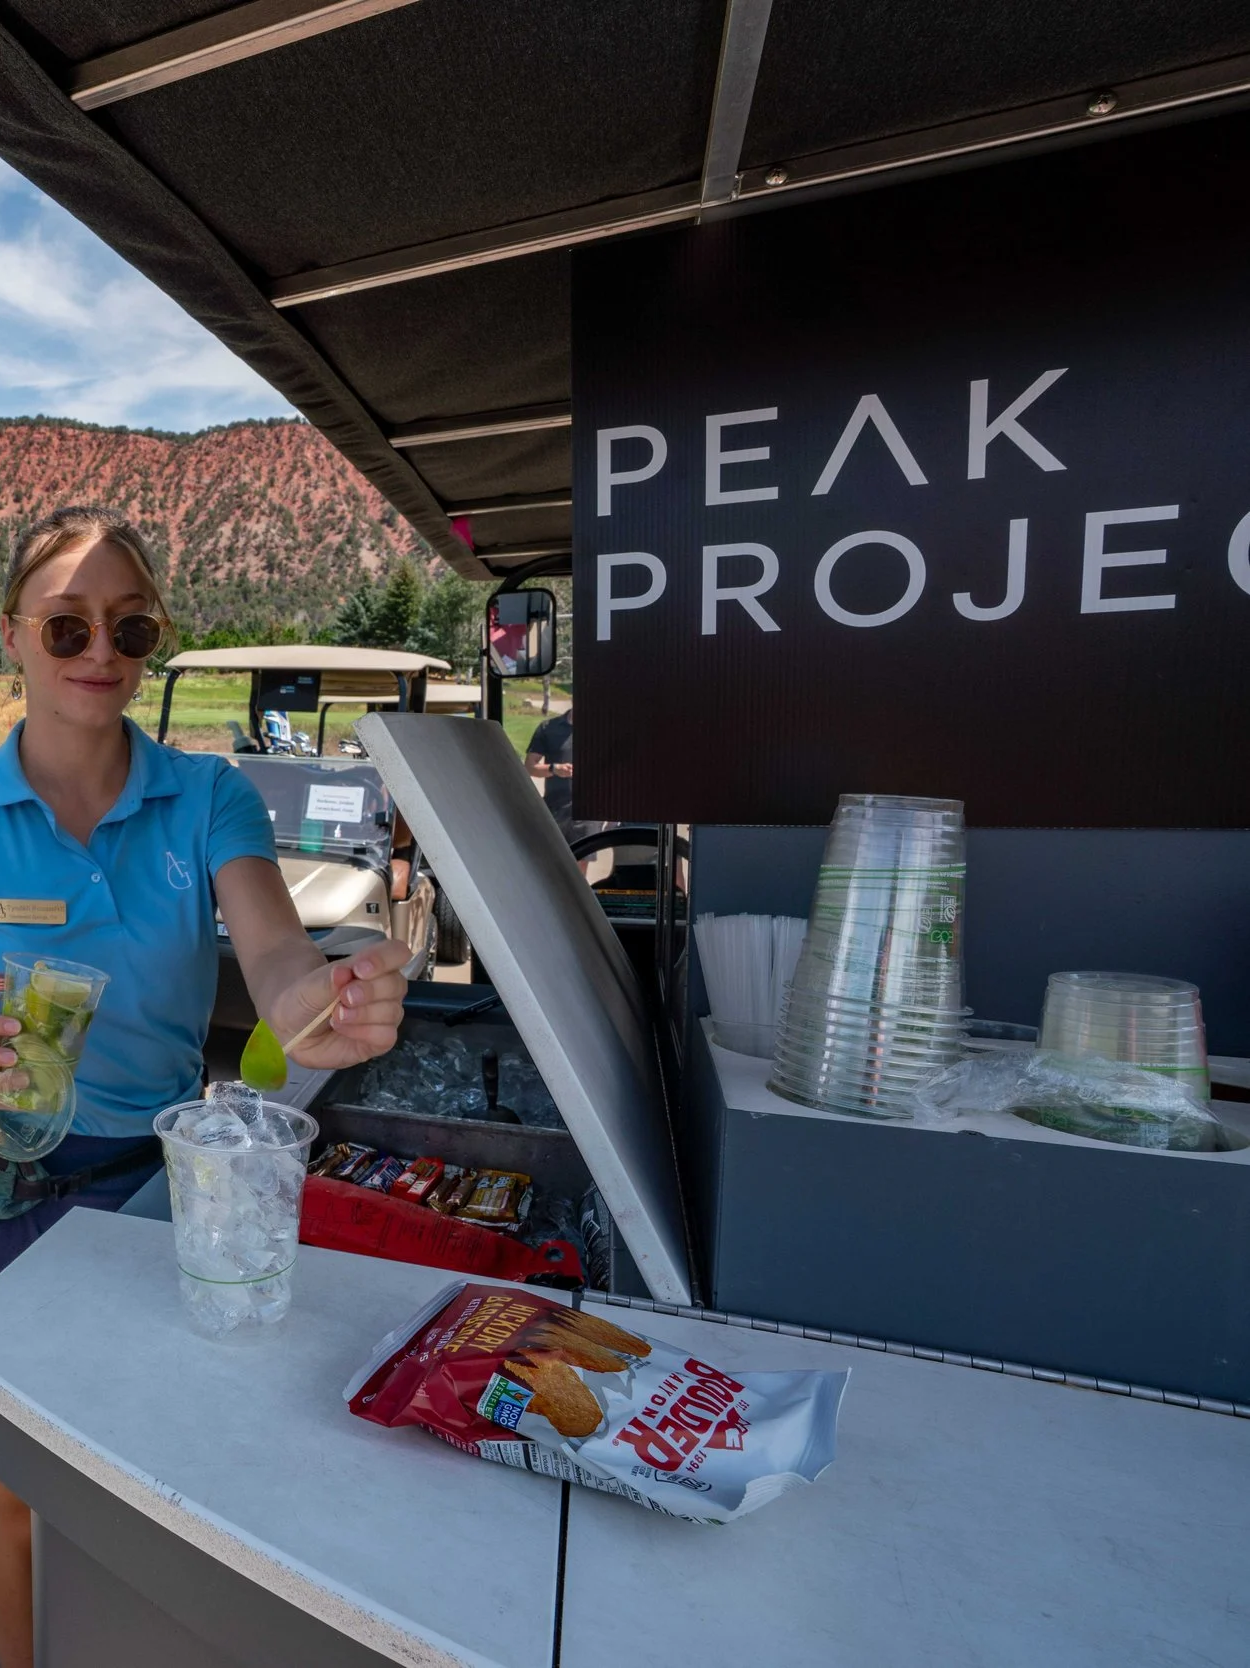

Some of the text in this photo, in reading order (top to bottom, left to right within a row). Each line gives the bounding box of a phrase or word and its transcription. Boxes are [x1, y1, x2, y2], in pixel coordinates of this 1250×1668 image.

[596, 368, 1069, 517] PEAK
[596, 504, 1250, 641] PROJE
[468, 1303, 538, 1354] HICKORY
[500, 1403, 513, 1425] GMO
[508, 1406, 521, 1428] NON
[616, 1357, 745, 1472] BOULDER
[641, 1372, 684, 1419] ANYON
[685, 1449, 707, 1474] 1994
